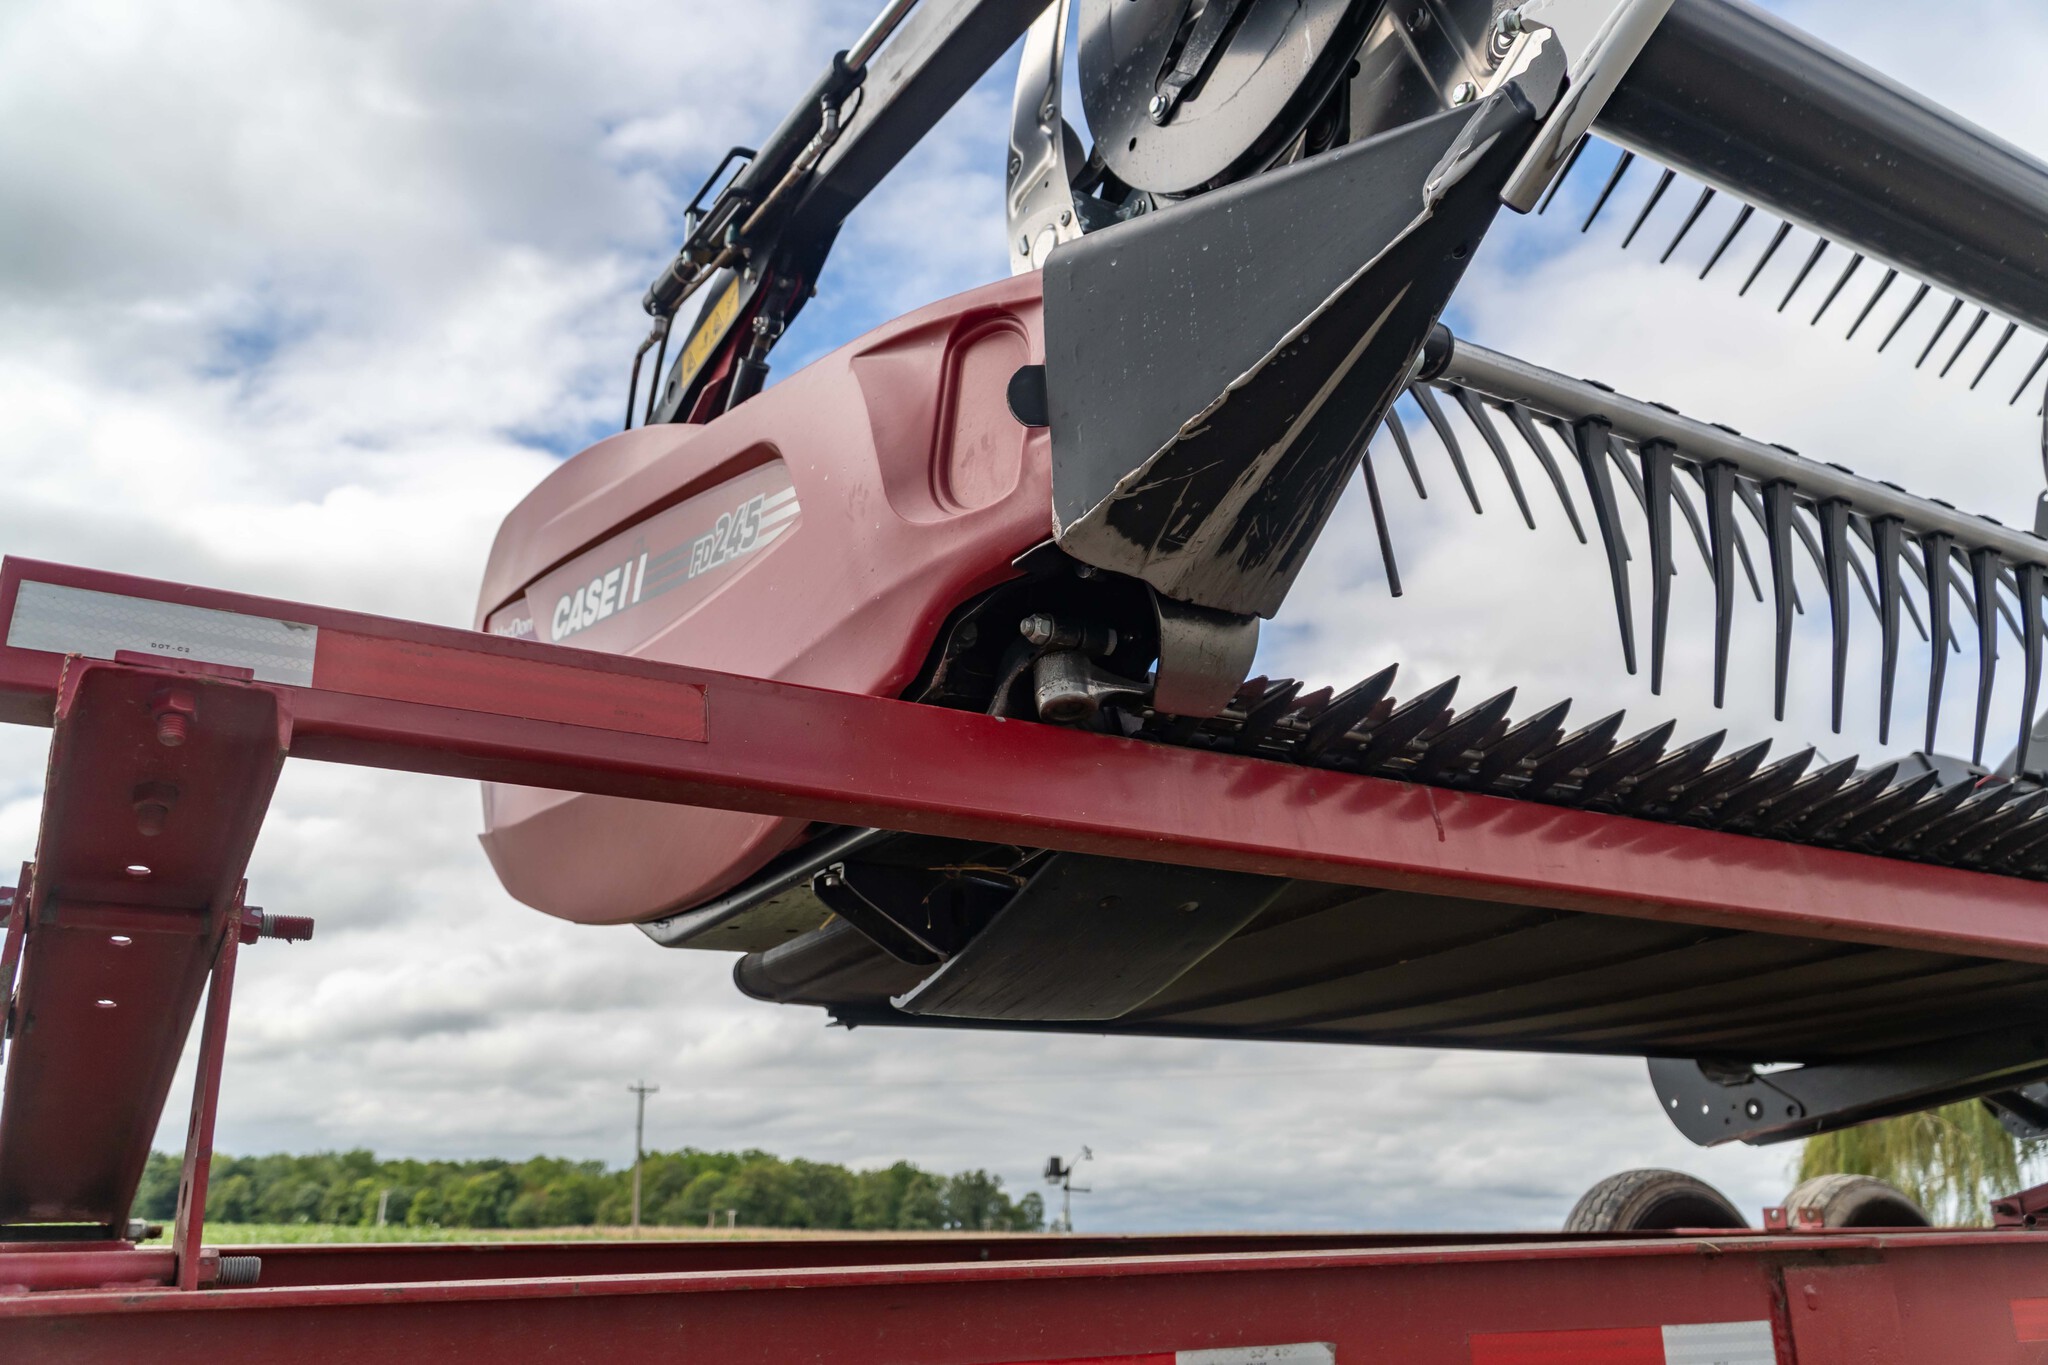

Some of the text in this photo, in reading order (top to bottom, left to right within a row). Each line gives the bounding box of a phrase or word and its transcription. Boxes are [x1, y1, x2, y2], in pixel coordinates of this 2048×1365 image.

[688, 492, 766, 579] FD245
[551, 567, 621, 642] CASE
[151, 642, 190, 653] DOT-C2
